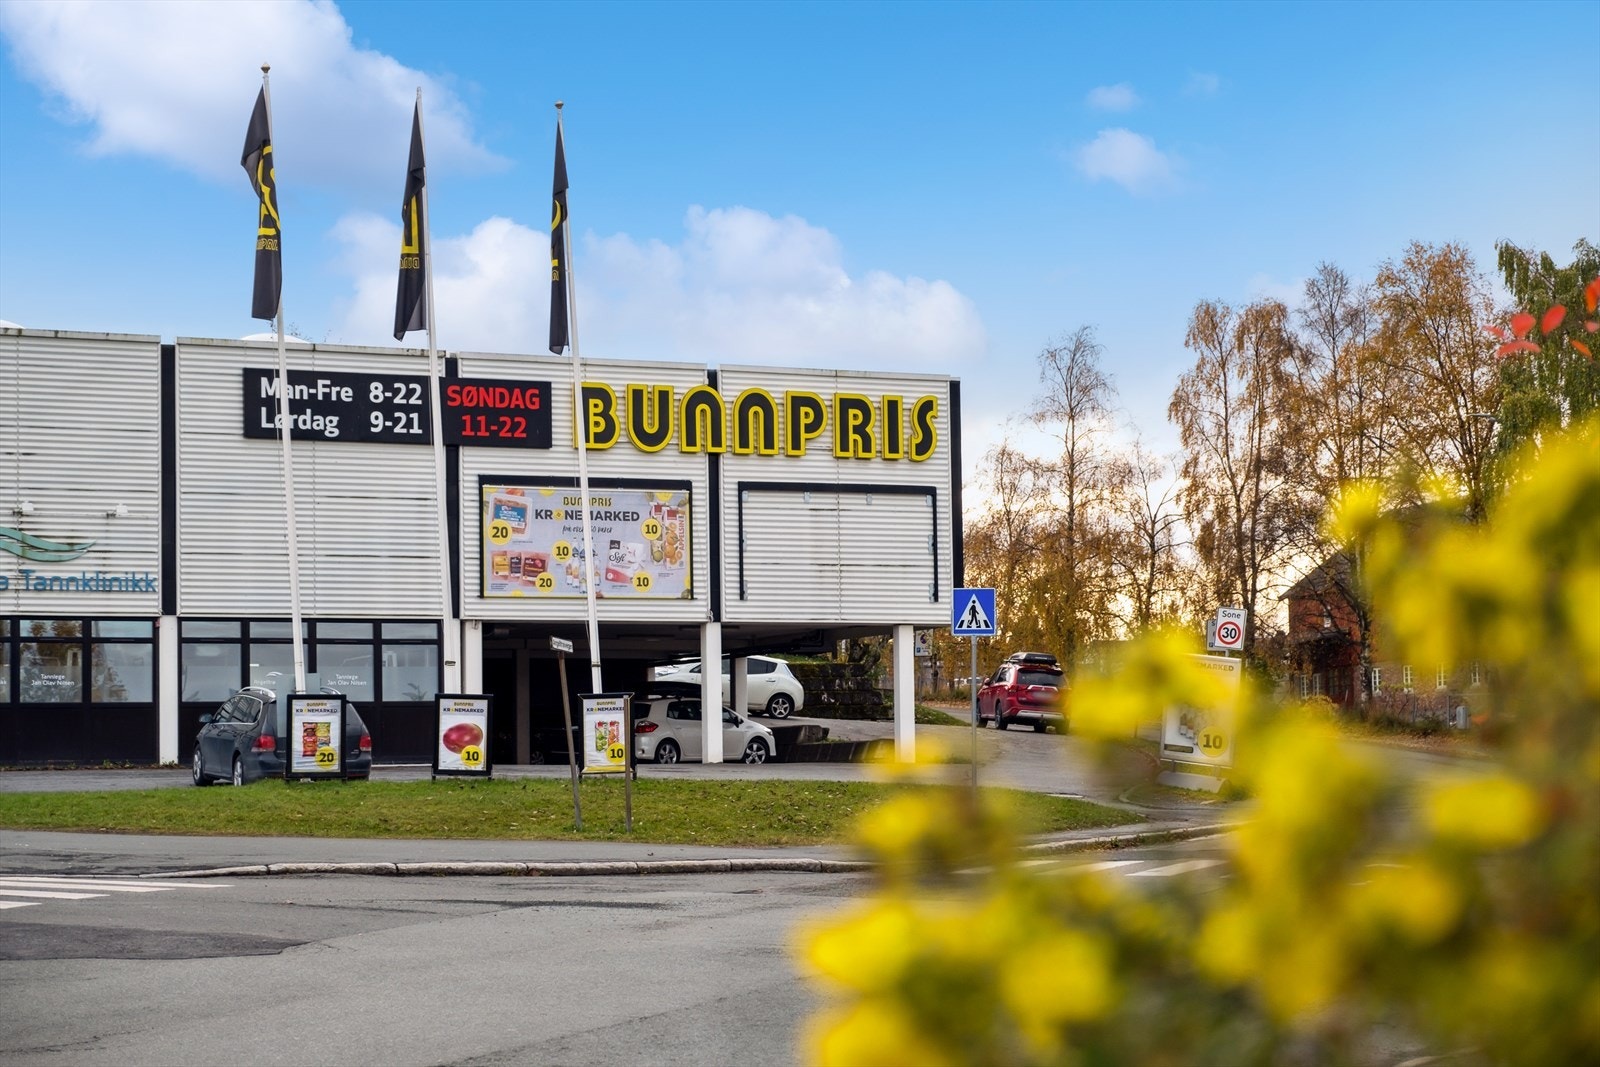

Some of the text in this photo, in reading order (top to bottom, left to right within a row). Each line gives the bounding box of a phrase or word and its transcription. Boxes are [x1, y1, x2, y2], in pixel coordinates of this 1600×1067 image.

[261, 377, 422, 404] Man-Fre 8-22
[447, 385, 540, 410] SØNDAG
[261, 407, 423, 437] Lørdag 9-21
[461, 415, 527, 438] 11-22
[573, 382, 938, 462] BUNNPRIS
[563, 496, 612, 507] BUNPRIS
[492, 527, 508, 538] 20
[645, 525, 658, 535] 10
[556, 546, 569, 556] 10
[18, 569, 158, 593] Tannklinikk
[539, 578, 552, 588] 20
[636, 577, 649, 587] 10
[1222, 611, 1241, 619] Sone
[1222, 627, 1237, 639] 30
[1203, 734, 1223, 748] 10
[320, 753, 334, 762] 20
[465, 751, 479, 761] 10
[610, 748, 624, 758] 10
